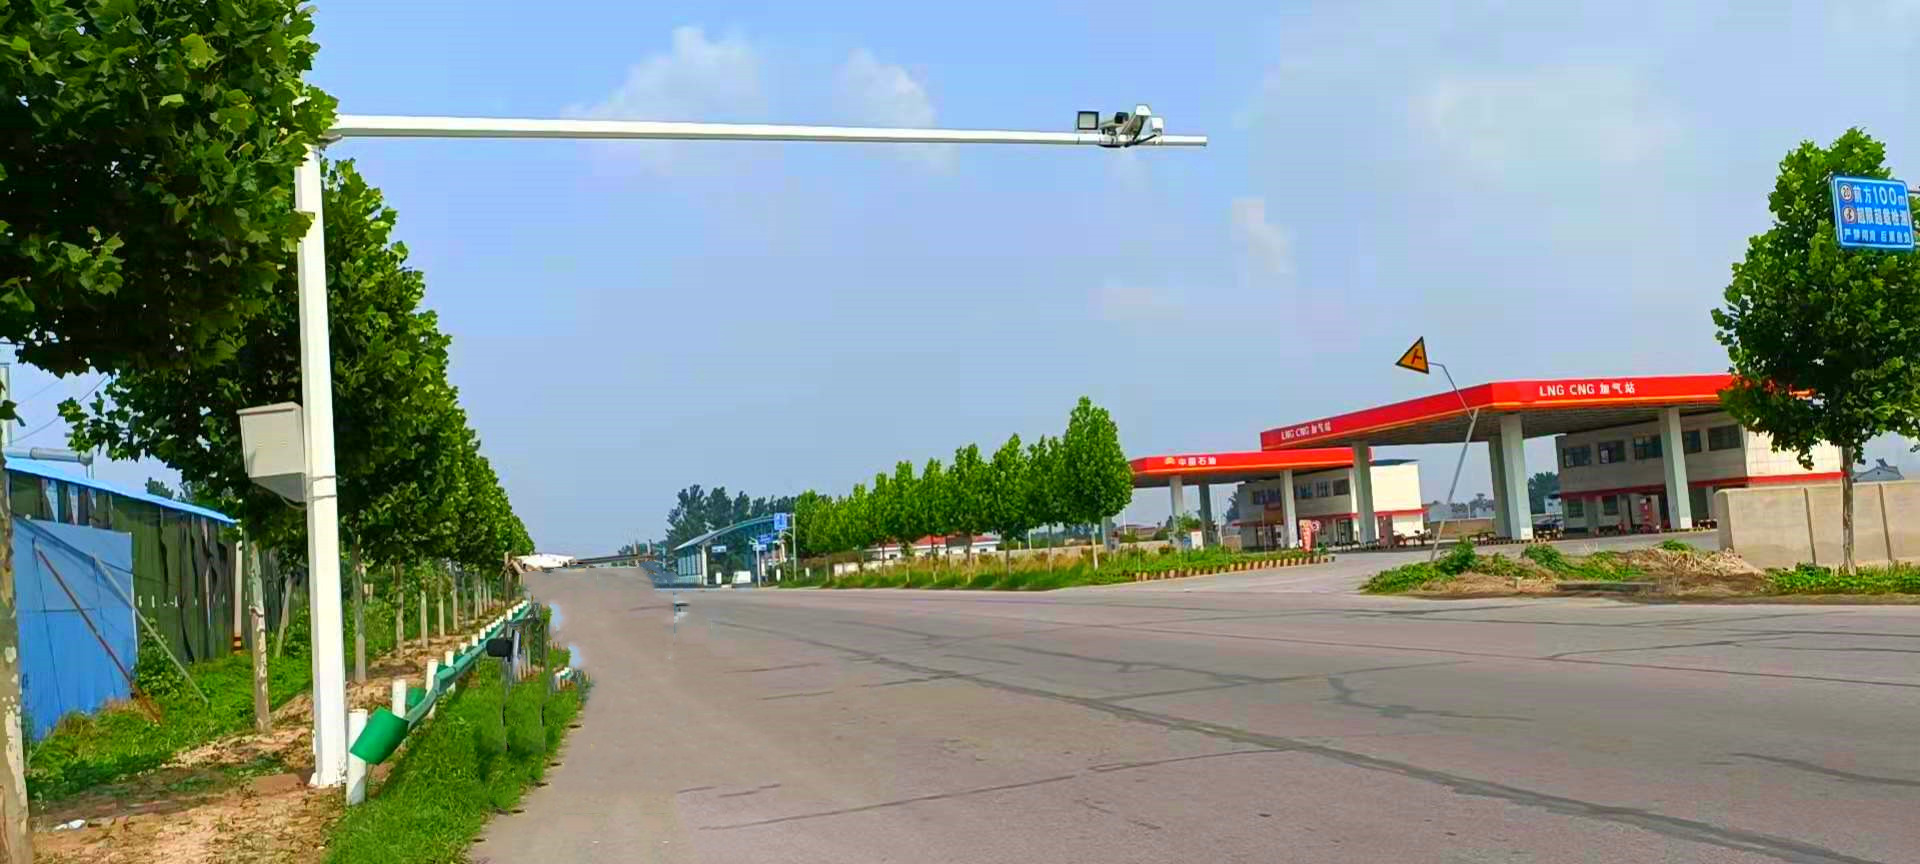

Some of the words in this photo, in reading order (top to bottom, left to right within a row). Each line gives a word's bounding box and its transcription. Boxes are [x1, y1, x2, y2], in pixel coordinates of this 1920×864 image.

[1539, 384, 1565, 397] LNG
[1569, 383, 1595, 396] CNG
[1600, 381, 1635, 395] 加气站
[1178, 456, 1216, 467] 中国石油
